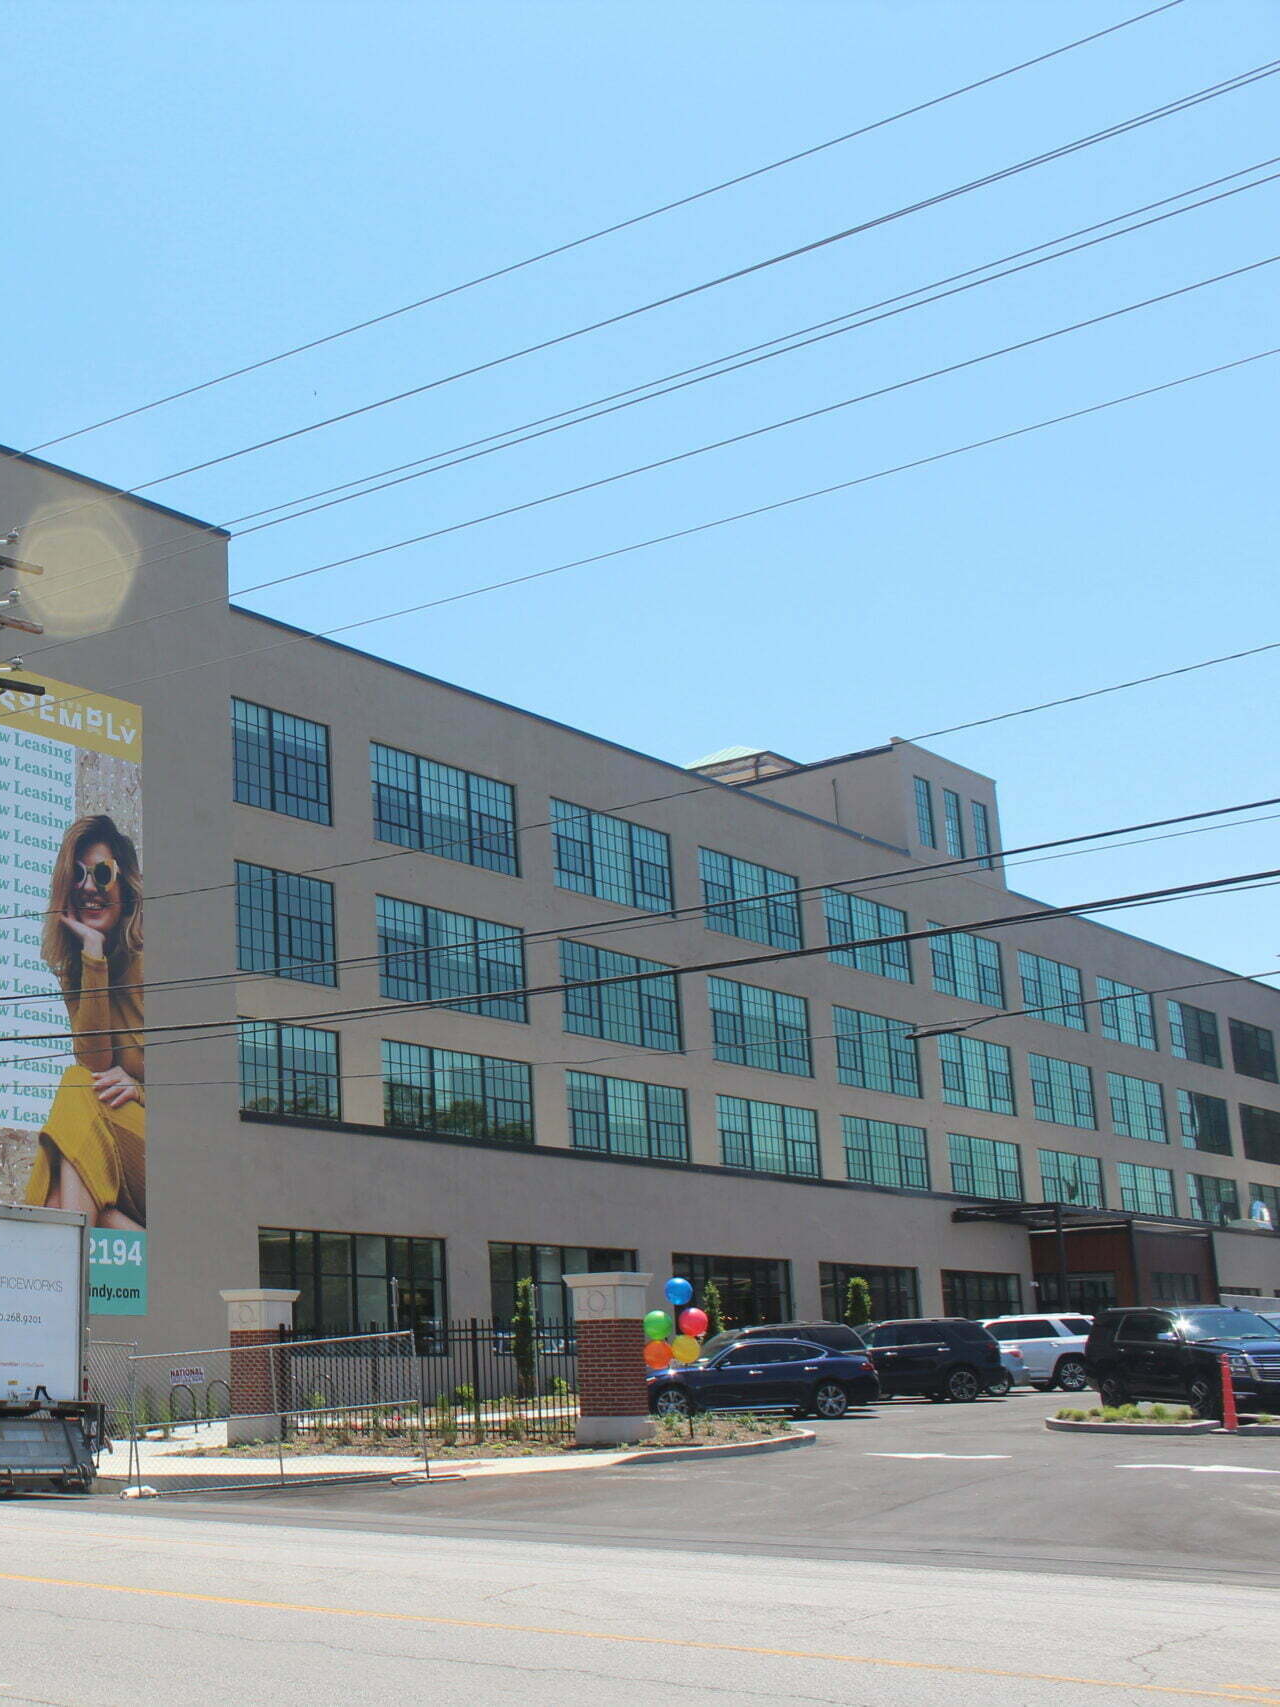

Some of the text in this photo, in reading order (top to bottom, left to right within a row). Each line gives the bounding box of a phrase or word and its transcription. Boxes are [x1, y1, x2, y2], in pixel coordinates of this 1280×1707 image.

[14, 731, 73, 764] Leasing
[14, 756, 73, 788] Leasing
[14, 780, 73, 811] Leasing
[14, 829, 62, 852] Leasin
[13, 853, 53, 875] Leasi
[13, 878, 50, 898] Leas
[13, 953, 50, 973] Leas
[13, 978, 60, 998] Leasi
[13, 1055, 64, 1075] Leasin
[13, 1080, 54, 1100] Leasi
[13, 1106, 49, 1125] Leas
[170, 1367, 204, 1378] NATIONAL
